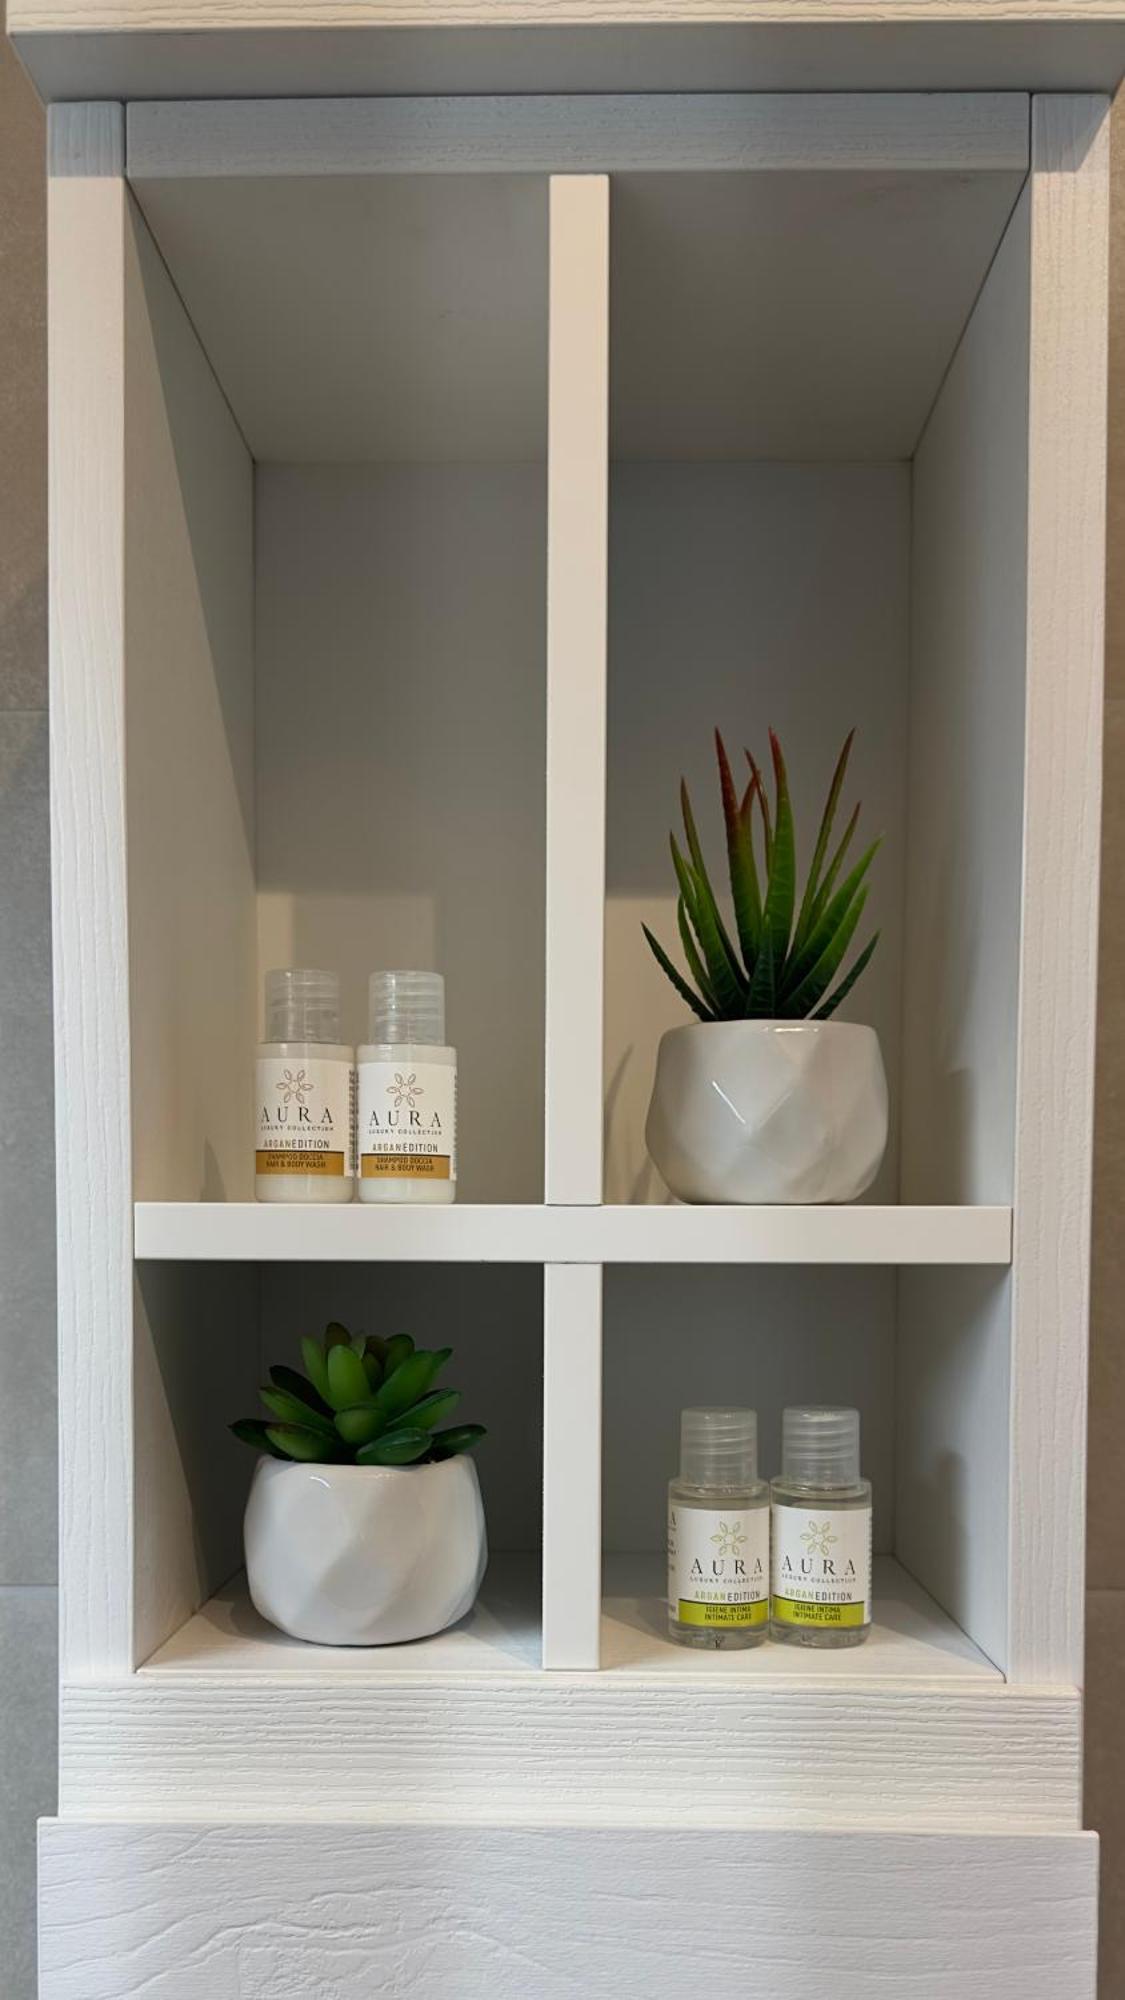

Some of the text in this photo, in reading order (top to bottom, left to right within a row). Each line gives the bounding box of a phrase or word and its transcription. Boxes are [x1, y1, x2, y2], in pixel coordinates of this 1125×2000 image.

[261, 1106, 333, 1123] AURA
[369, 1110, 441, 1127] AURA
[691, 1558, 762, 1576] AURA
[781, 1555, 855, 1575] AURA
[704, 1613, 752, 1621] INTIMATE CARE
[793, 1611, 841, 1621] INTIMATE CARE
